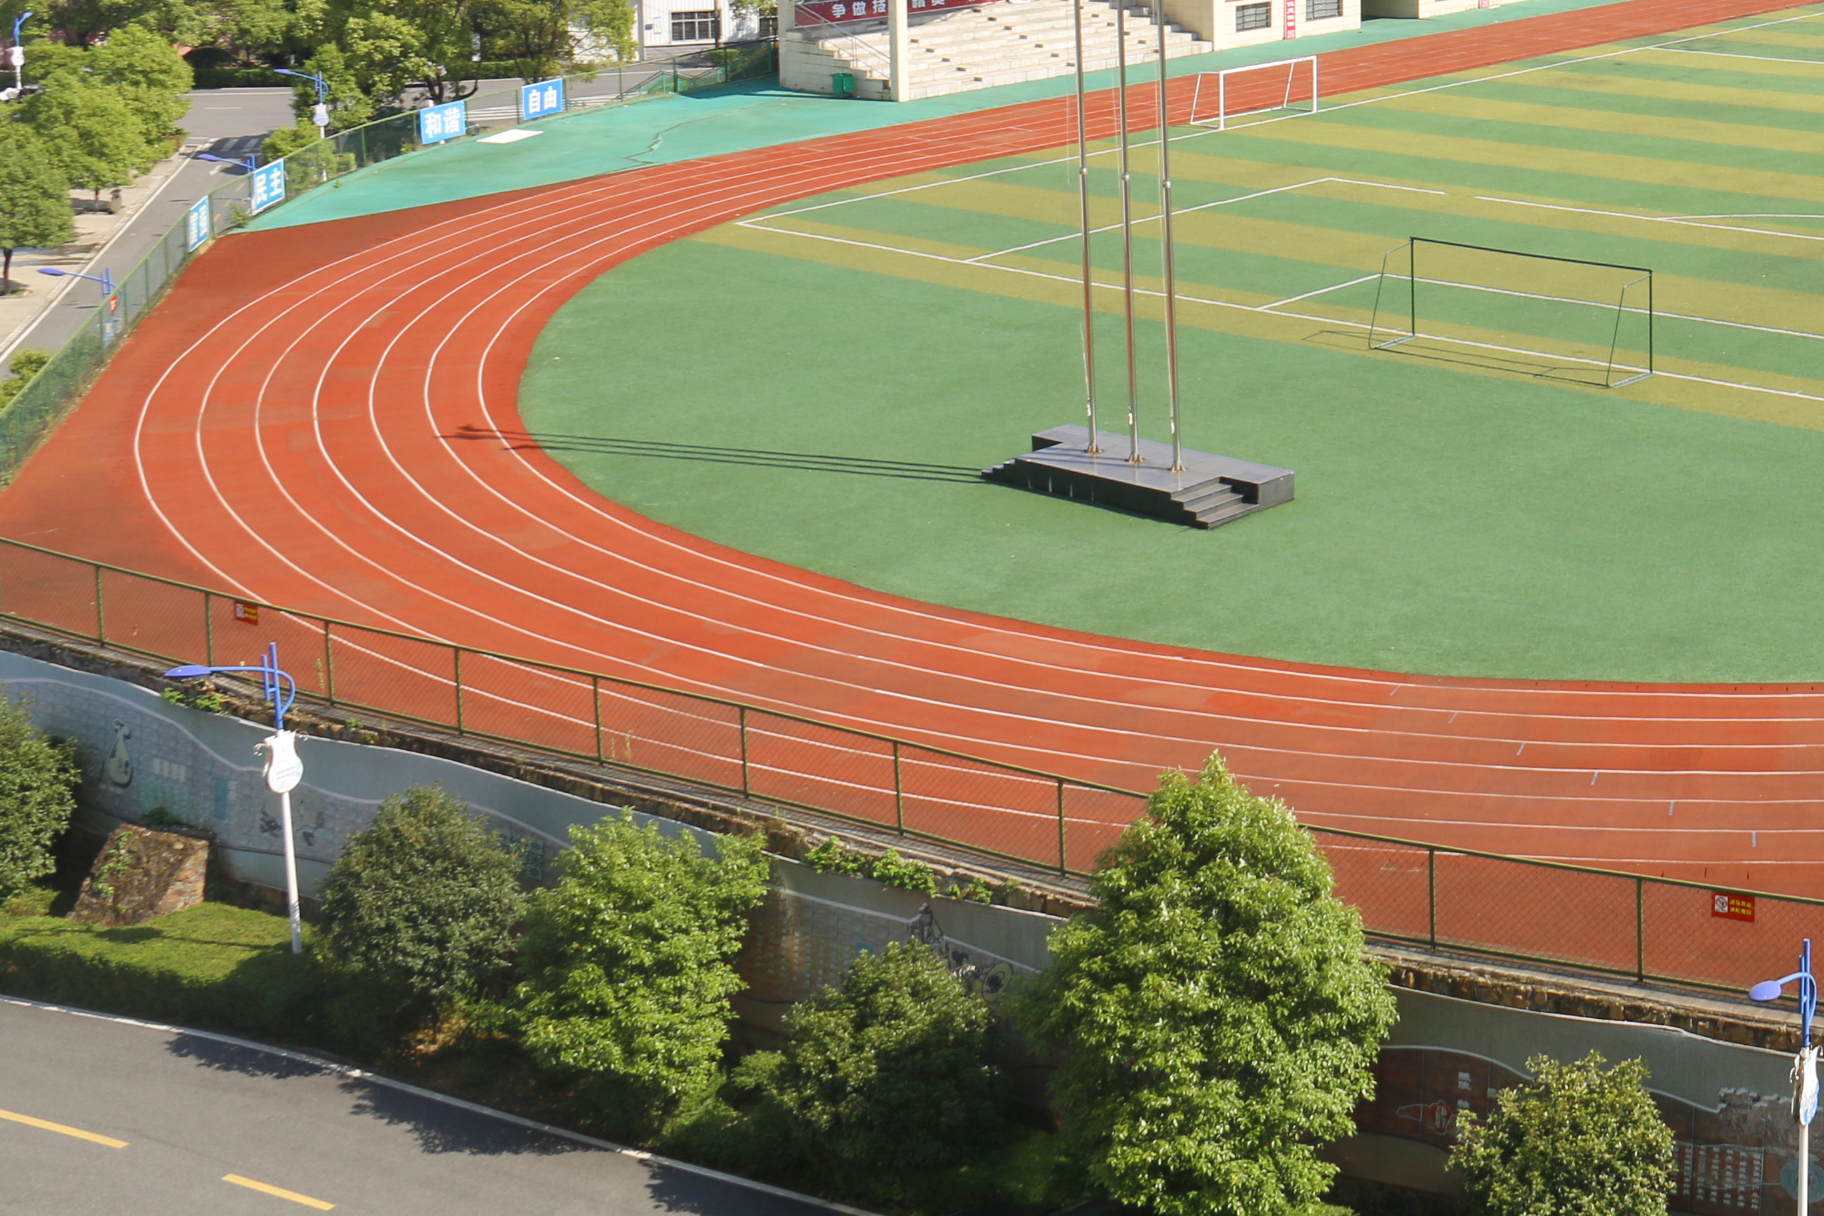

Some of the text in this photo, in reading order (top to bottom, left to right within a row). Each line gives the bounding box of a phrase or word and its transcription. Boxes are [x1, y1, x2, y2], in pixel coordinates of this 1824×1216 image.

[528, 85, 557, 114] 自由
[425, 107, 460, 138] 和谐
[256, 167, 282, 205] 民主
